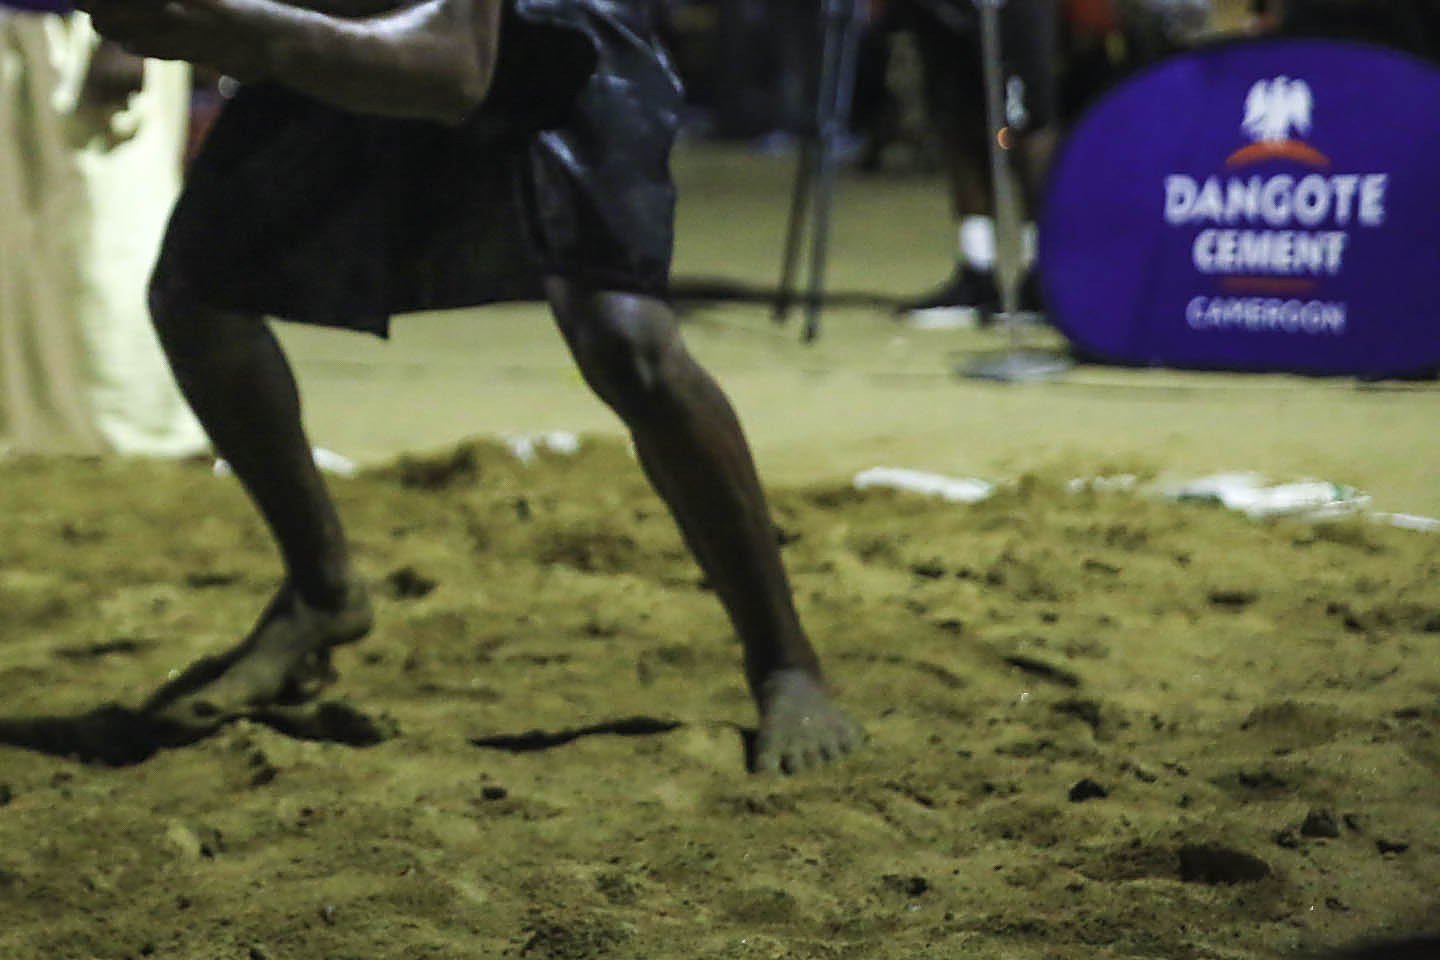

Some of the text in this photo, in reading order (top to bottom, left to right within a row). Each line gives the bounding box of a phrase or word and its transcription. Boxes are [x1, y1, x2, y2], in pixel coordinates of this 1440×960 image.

[1164, 172, 1387, 226] DANGOTE
[1192, 229, 1347, 275] CEMENT
[1186, 296, 1347, 333] CAMEROON
